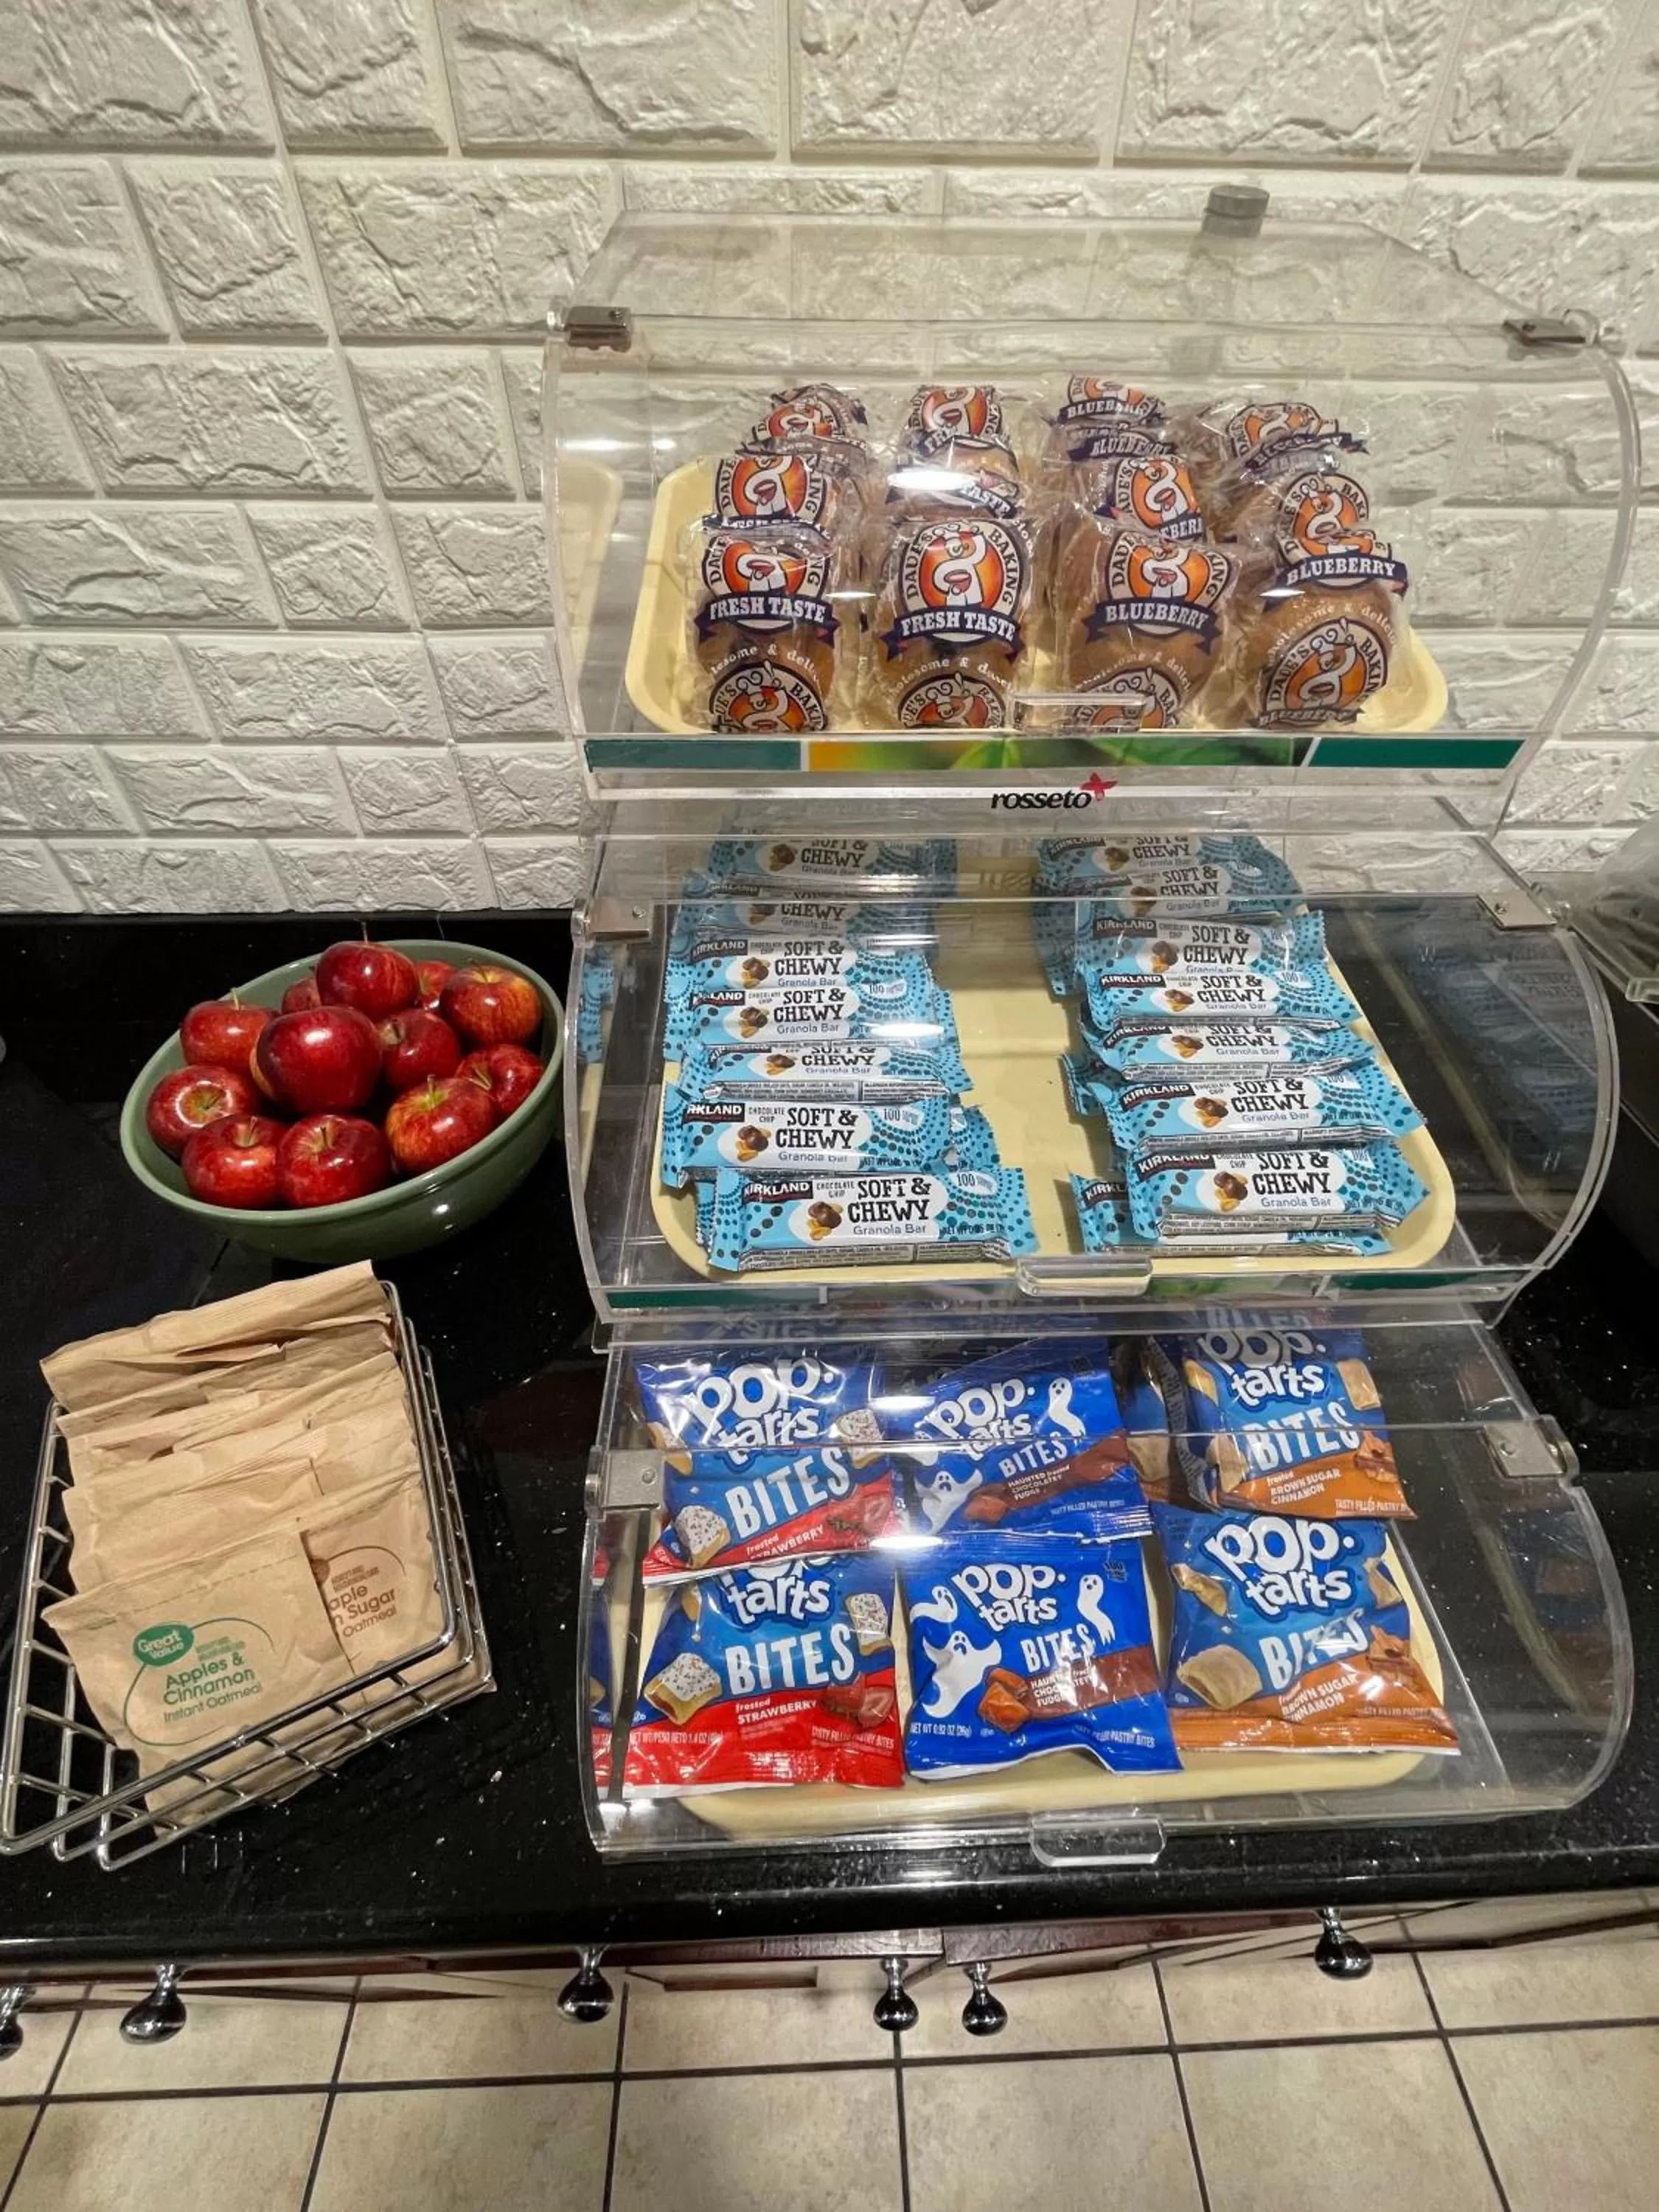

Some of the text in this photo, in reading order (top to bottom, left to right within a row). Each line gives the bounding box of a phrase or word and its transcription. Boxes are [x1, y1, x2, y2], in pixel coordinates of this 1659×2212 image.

[989, 526, 1017, 606] BAKING
[1287, 557, 1396, 586] BLUEBERRY
[710, 597, 827, 624] FRESH TASTE
[1106, 602, 1209, 629] BLUEBERRY
[901, 611, 1016, 642] FRESH TASTE
[767, 642, 777, 656] &
[1270, 644, 1311, 701] DADE'S
[990, 789, 1092, 810] rosseto
[801, 848, 865, 868] CHEWY
[1133, 844, 1190, 859] CHEWY
[1162, 866, 1218, 884] SOFT &
[781, 904, 846, 922] CHEWY
[1191, 925, 1251, 945] SOFT &
[784, 940, 846, 957] SOFT &
[1183, 945, 1249, 965] CHEWY
[775, 958, 843, 976] CHEWY
[777, 978, 837, 987] Granola Bar
[1101, 975, 1161, 985] KIRKLAND
[1200, 975, 1262, 990] SOFT &
[783, 989, 825, 1005] SOFT
[829, 987, 847, 1002] &
[1197, 990, 1265, 1003] CHEWY
[773, 1004, 844, 1023] CHEWY
[776, 1023, 839, 1034] Granola Bar
[1206, 1034, 1279, 1047] CHEWY
[801, 1055, 874, 1066] CHEWY
[1216, 1048, 1259, 1056] Granola
[1123, 1084, 1190, 1105] KIRKLAND
[1233, 1079, 1280, 1095] SOFT
[1285, 1077, 1304, 1091] &
[1231, 1093, 1309, 1113] CHEWY
[787, 1107, 835, 1127] SOFT
[838, 1109, 859, 1127] &
[884, 1108, 900, 1121] 100
[1242, 1111, 1310, 1123] Granola Bar
[775, 1129, 855, 1150] CHEWY
[1259, 1152, 1306, 1171] SOFT
[1310, 1150, 1329, 1169] &
[744, 1181, 810, 1197] KIRKLAND
[858, 1179, 906, 1200] SOFT
[911, 1178, 932, 1196] &
[956, 1174, 975, 1186] 100
[1251, 1172, 1332, 1195] CHEWY
[848, 1199, 930, 1223] CHEWY
[1261, 1197, 1332, 1208] Granola Bar
[853, 1223, 927, 1237] Granola Bar
[1231, 1363, 1326, 1407] tarts
[717, 1407, 820, 1464] tarts
[962, 1413, 1032, 1461] tarts
[1244, 1401, 1361, 1472] BITES
[997, 1431, 1068, 1478] BITES
[1270, 1468, 1341, 1496] BROWN SUGAR
[725, 1447, 852, 1539] BITES
[1271, 1483, 1326, 1505] CINNAMON
[746, 1534, 779, 1555] frosted
[329, 1585, 368, 1611] aple
[727, 1575, 832, 1624] tarts
[1245, 1568, 1352, 1616] tarts
[347, 1587, 395, 1619] Sugar
[342, 1604, 397, 1638] Oatmeal
[978, 1596, 1058, 1632] tarts
[138, 1630, 183, 1653] Great
[1020, 1622, 1096, 1673] BITES
[1259, 1607, 1369, 1690] BITES
[725, 1623, 856, 1695] BITES
[166, 1651, 245, 1690] Apples &
[163, 1668, 256, 1705] Cinnamon
[1319, 1672, 1359, 1696] SUGAR
[164, 1683, 263, 1723] Instant Oatmeal
[735, 1699, 771, 1713] frosted
[738, 1700, 818, 1725] STRAWBERRY
[1111, 1729, 1135, 1744] PASTRY
